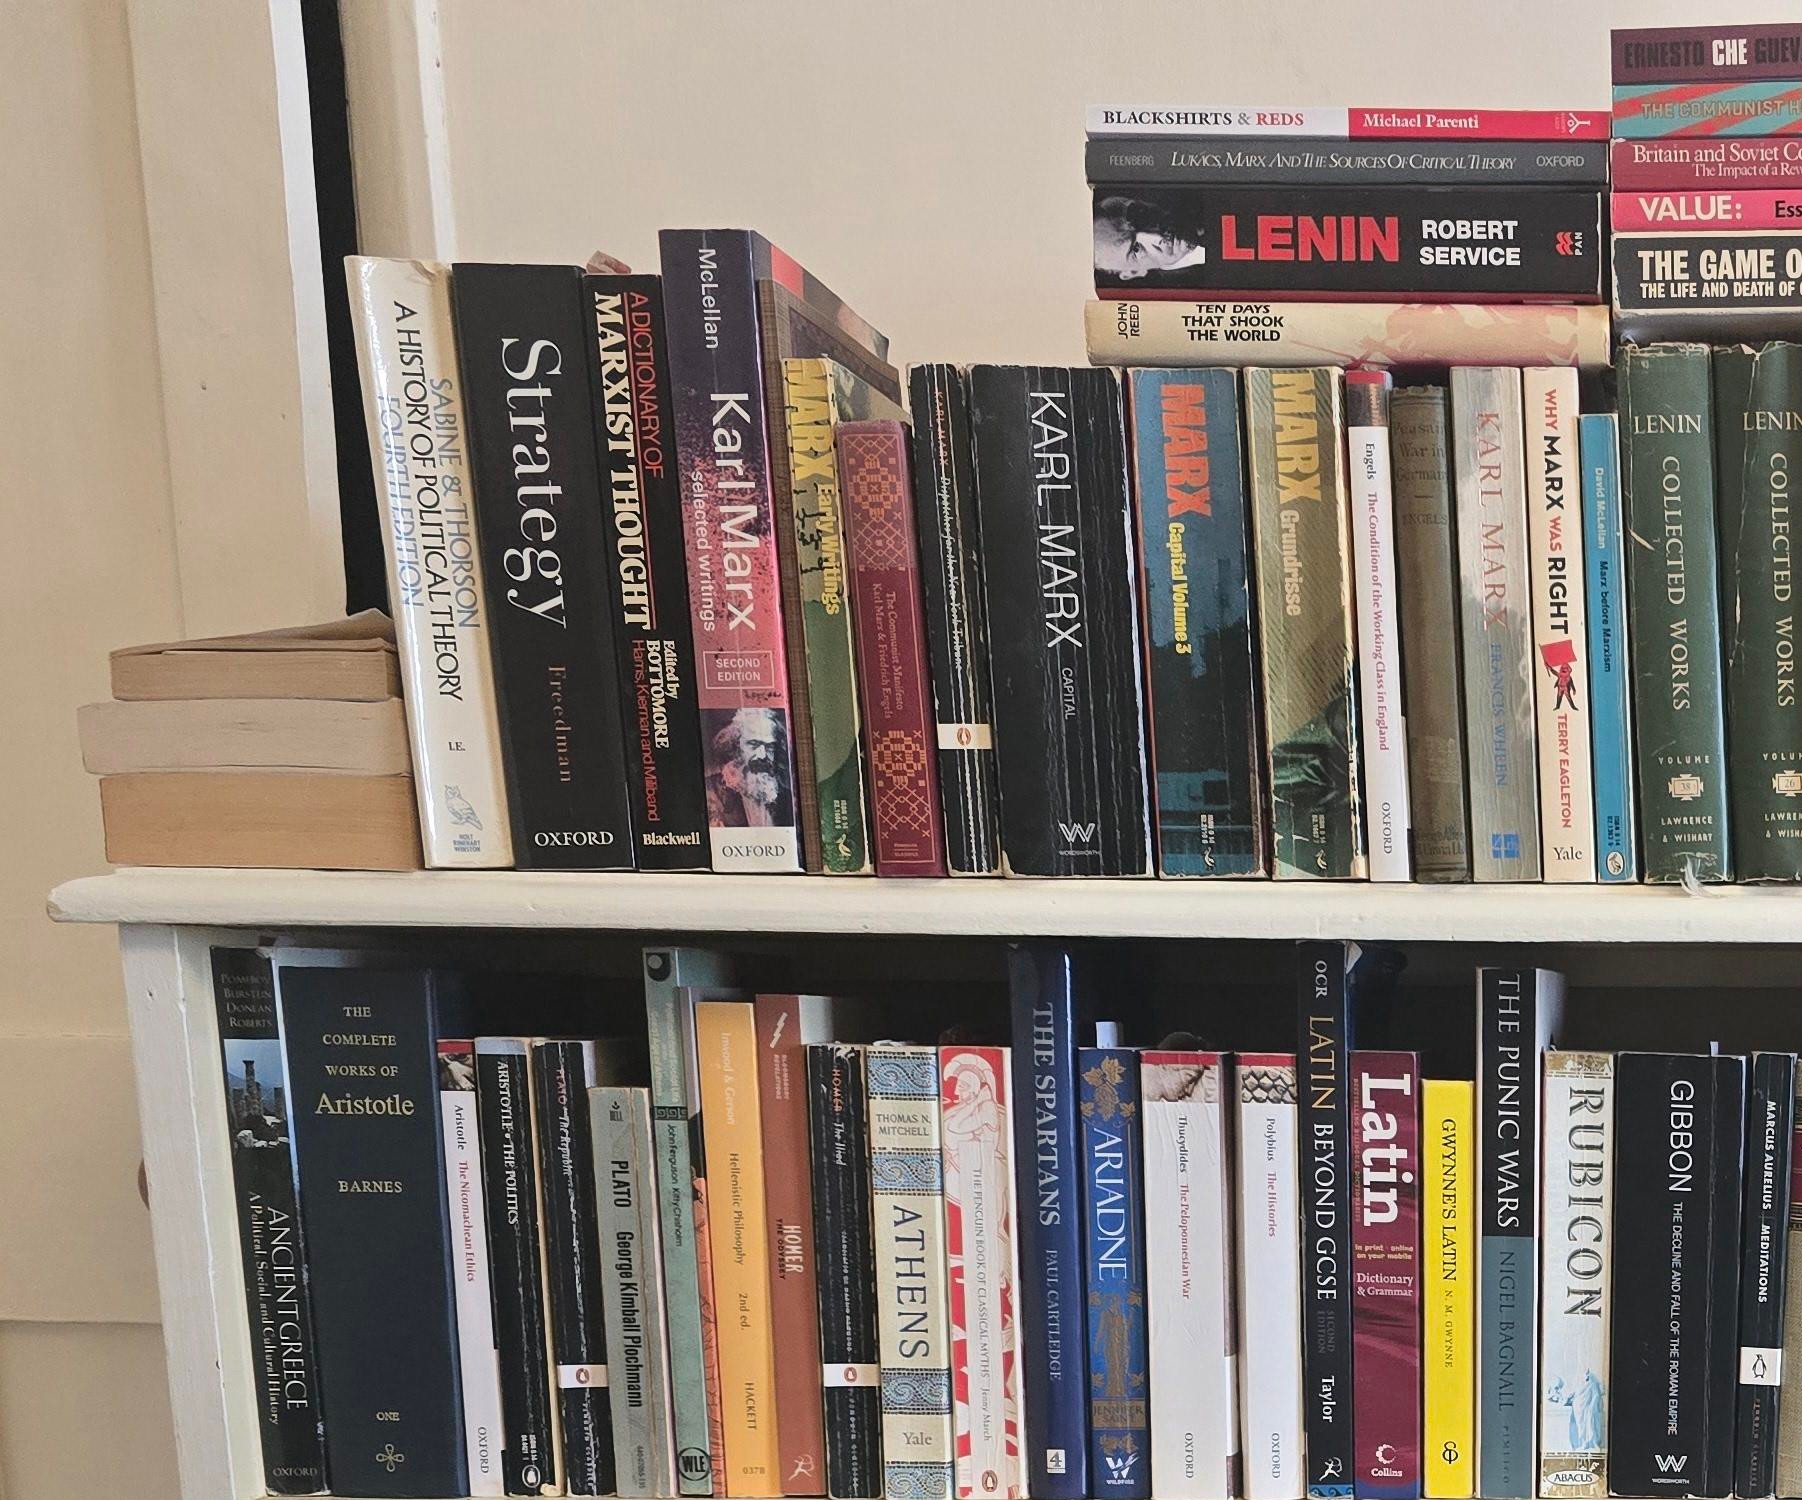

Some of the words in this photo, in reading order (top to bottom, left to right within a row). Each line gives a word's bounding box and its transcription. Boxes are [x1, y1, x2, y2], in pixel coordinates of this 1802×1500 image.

[1711, 39, 1747, 65] CHE
[1103, 111, 1232, 126] BLACKSHIRTS
[1237, 113, 1251, 126] &
[1256, 113, 1304, 126] REDS
[1364, 114, 1421, 129] Michael
[1425, 114, 1479, 130] Parenti
[1536, 155, 1584, 168] OXFORD
[1633, 145, 1691, 163] Britain
[1694, 147, 1724, 163] and
[1729, 144, 1779, 162] Soviet
[1639, 197, 1742, 222] VALUE:
[1222, 215, 1398, 262] LENIN
[1422, 221, 1518, 240] ROBERT
[1419, 246, 1521, 266] SERVICE
[1637, 250, 1693, 280] THE
[1699, 249, 1778, 279] GAME
[1640, 283, 1666, 298] THE
[1670, 283, 1697, 298] LIFE
[1702, 282, 1729, 297] AND
[1733, 282, 1775, 297] DEATH
[1779, 282, 1796, 297] OF
[1196, 304, 1227, 314] TEN
[1232, 304, 1270, 314] DAYS
[1182, 316, 1223, 327] THAT
[1229, 316, 1284, 328] SHOOK
[1187, 330, 1218, 341] THE
[1224, 330, 1280, 342] WORLD
[593, 292, 634, 456] MARXIST
[1544, 388, 1558, 431] WHY
[1634, 414, 1701, 434] LENIN
[710, 392, 751, 496] Karl
[1029, 391, 1069, 508] KARL
[1544, 434, 1565, 512] MARX
[500, 338, 567, 630] Strategy
[1549, 516, 1562, 552] WAS
[1661, 456, 1686, 606] COLLECTED
[611, 462, 651, 629] THOUGHT
[720, 505, 757, 631] Marx
[1039, 525, 1083, 649] MARX
[1547, 556, 1569, 635] RIGHT
[715, 658, 760, 670] SECOND
[1669, 618, 1690, 711] WORKS
[717, 671, 760, 682] EDITION
[534, 831, 613, 847] OXFORD
[643, 833, 700, 847] Blackwell
[722, 844, 785, 858] OXFORD
[1553, 847, 1582, 861] Yale
[343, 1006, 371, 1017] THE
[323, 1034, 396, 1046] COMPLETE
[325, 1065, 373, 1077] WORKS
[379, 1065, 398, 1076] OF
[314, 1094, 414, 1117] Aristotle
[876, 1114, 913, 1124] THOMAS
[878, 1126, 929, 1136] MITCHELL
[1669, 1080, 1694, 1192] GIBBON
[1360, 1072, 1414, 1227] Latin
[339, 1181, 403, 1194] BARNES
[611, 1161, 629, 1207] PLATO
[1094, 1128, 1127, 1280] ARIADNE
[1563, 1085, 1606, 1319] RUBICON
[1758, 1224, 1770, 1303] MEDITATIONS
[893, 1205, 929, 1359] ATHENS
[1356, 1273, 1413, 1287] Dictionary
[1357, 1287, 1367, 1297] &
[1370, 1286, 1413, 1298] Grammar
[902, 1431, 932, 1445] Yale
[1371, 1465, 1403, 1477] Collins
[1554, 1473, 1593, 1484] ABACUS
